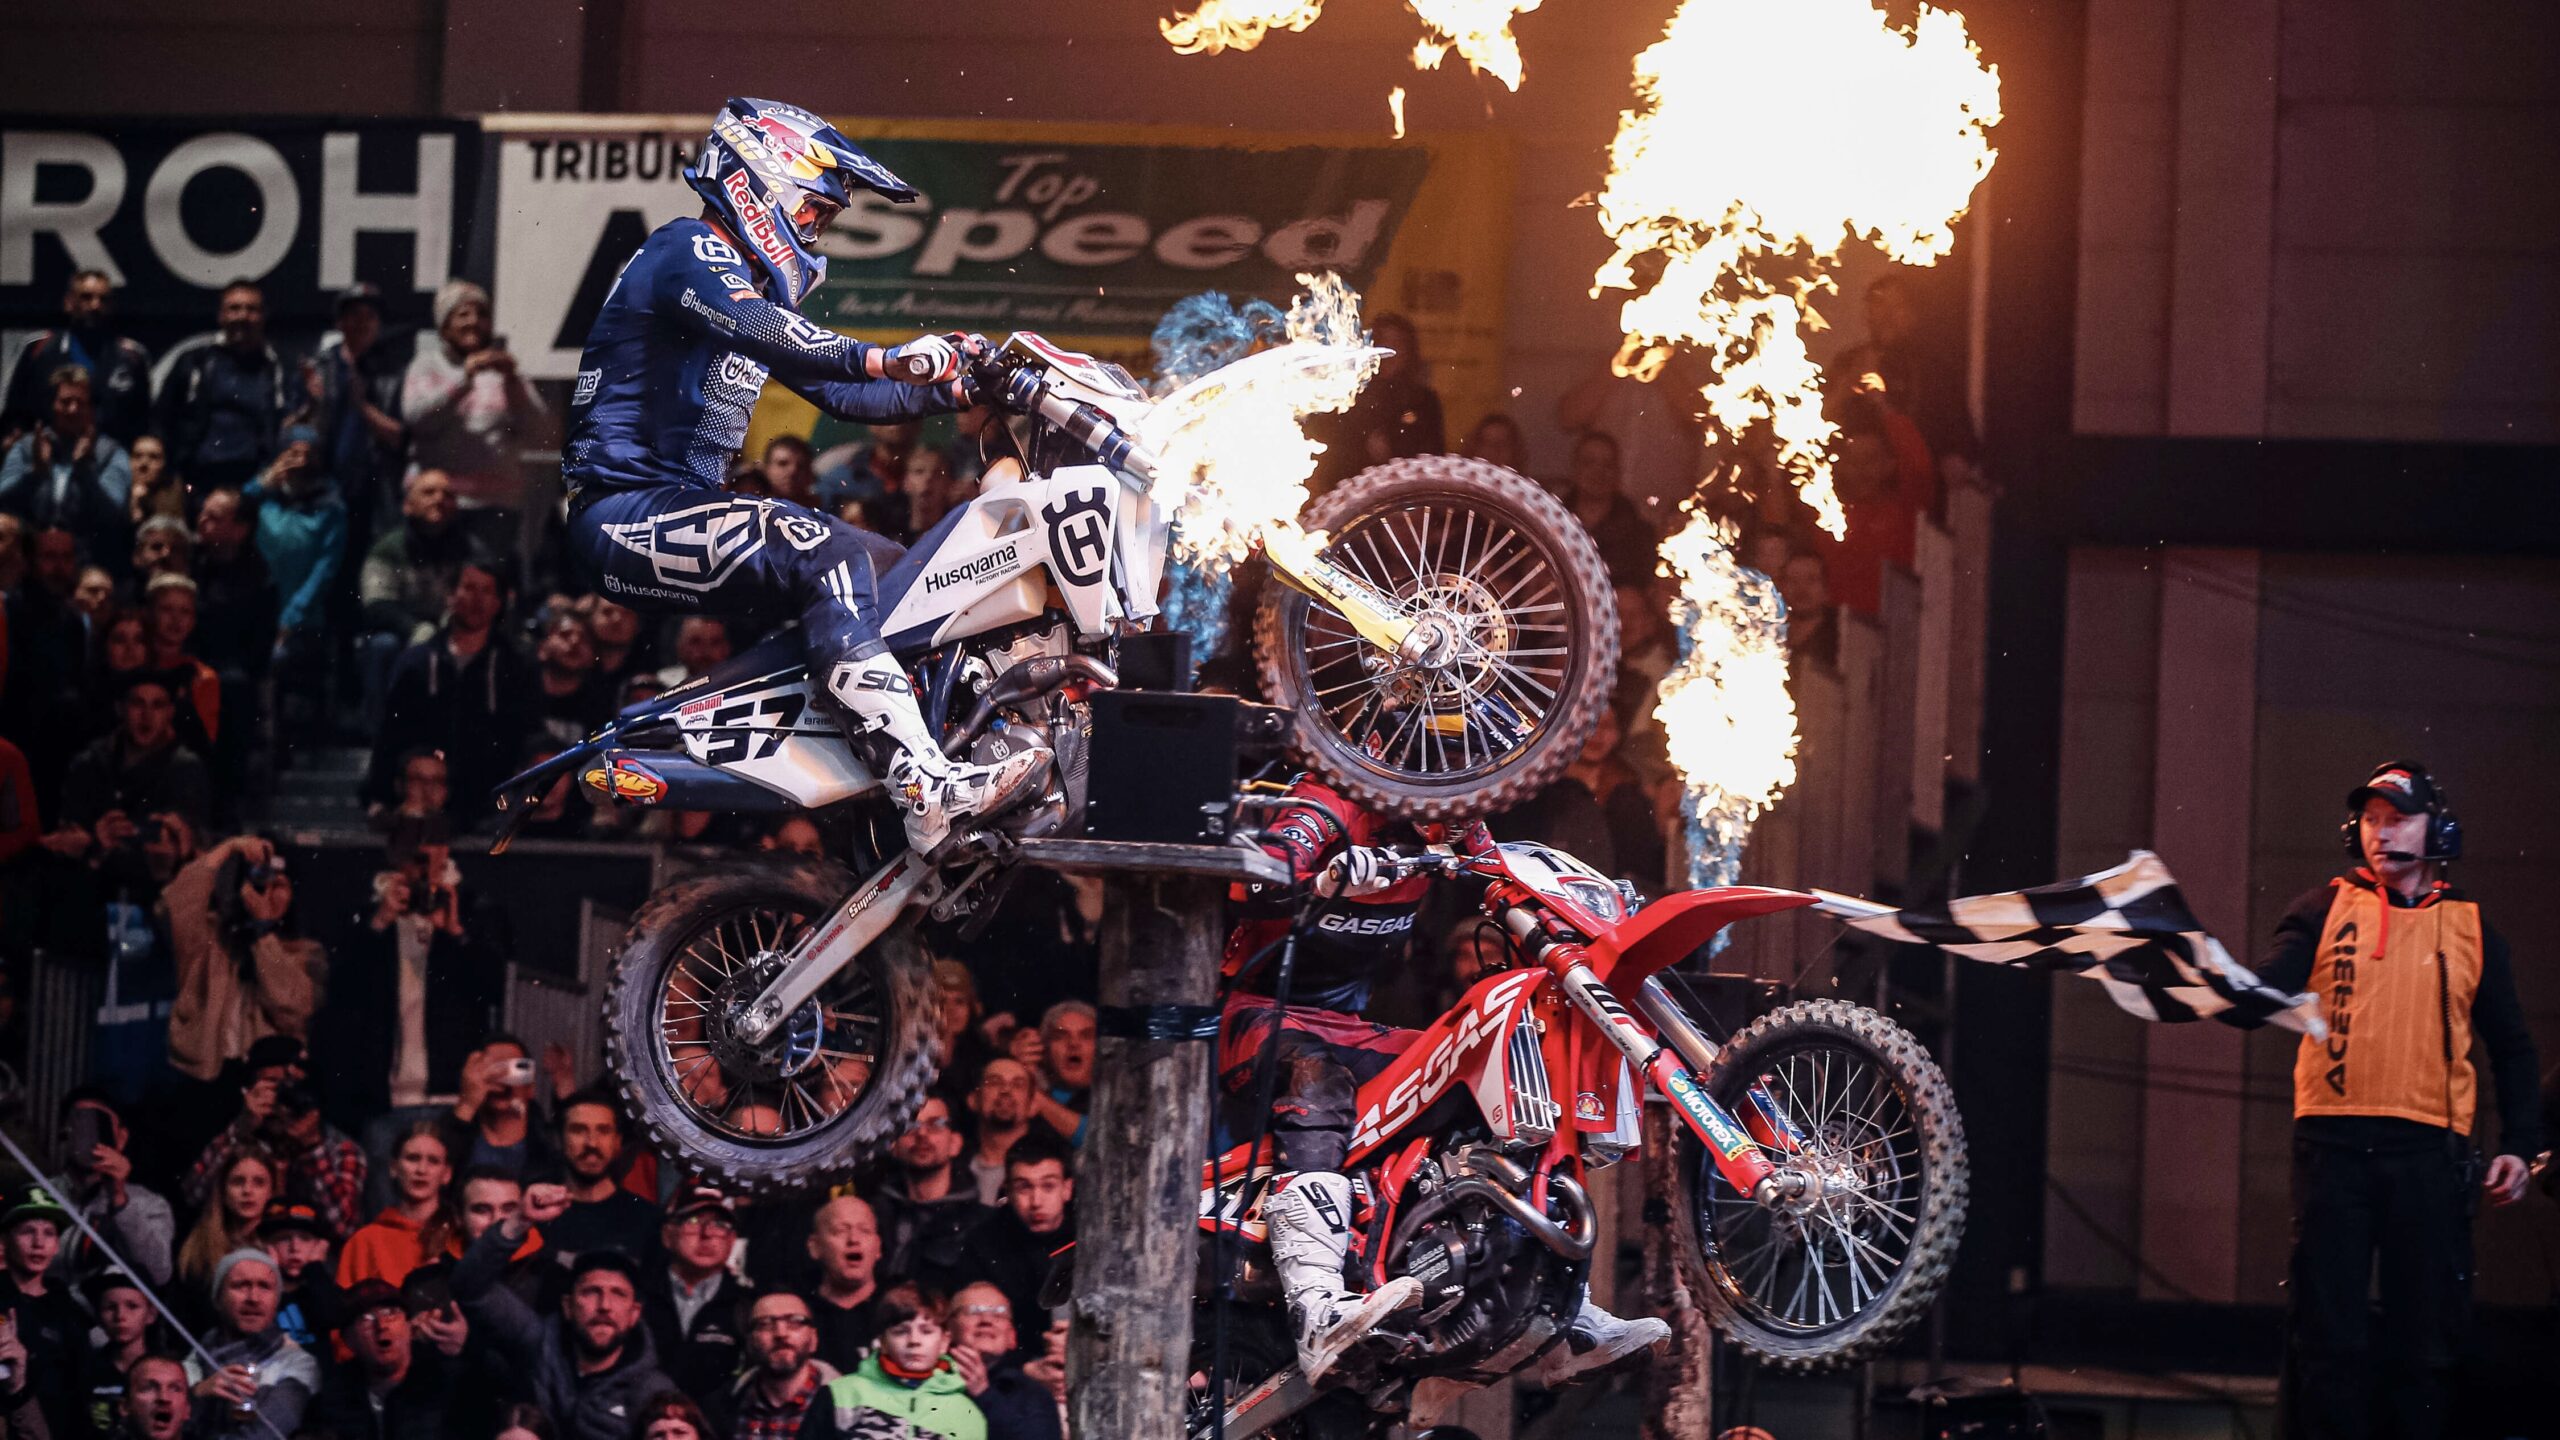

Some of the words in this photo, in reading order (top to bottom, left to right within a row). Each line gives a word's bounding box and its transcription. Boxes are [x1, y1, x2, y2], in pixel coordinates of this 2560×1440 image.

[1, 132, 456, 291] ROH
[999, 152, 1097, 219] Top
[811, 188, 1391, 276] Speed
[691, 297, 737, 330] Husqvarna
[622, 582, 699, 604] Husqvarna
[925, 545, 1018, 594] Husqvarna
[975, 570, 999, 586] FACTORY
[1000, 563, 1021, 577] RACING
[706, 692, 807, 765] 57
[815, 924, 844, 954] brembo
[1318, 911, 1417, 935] GASGAS
[2325, 921, 2358, 1097] ACERBIS
[1681, 1091, 1738, 1149] MOTOREX
